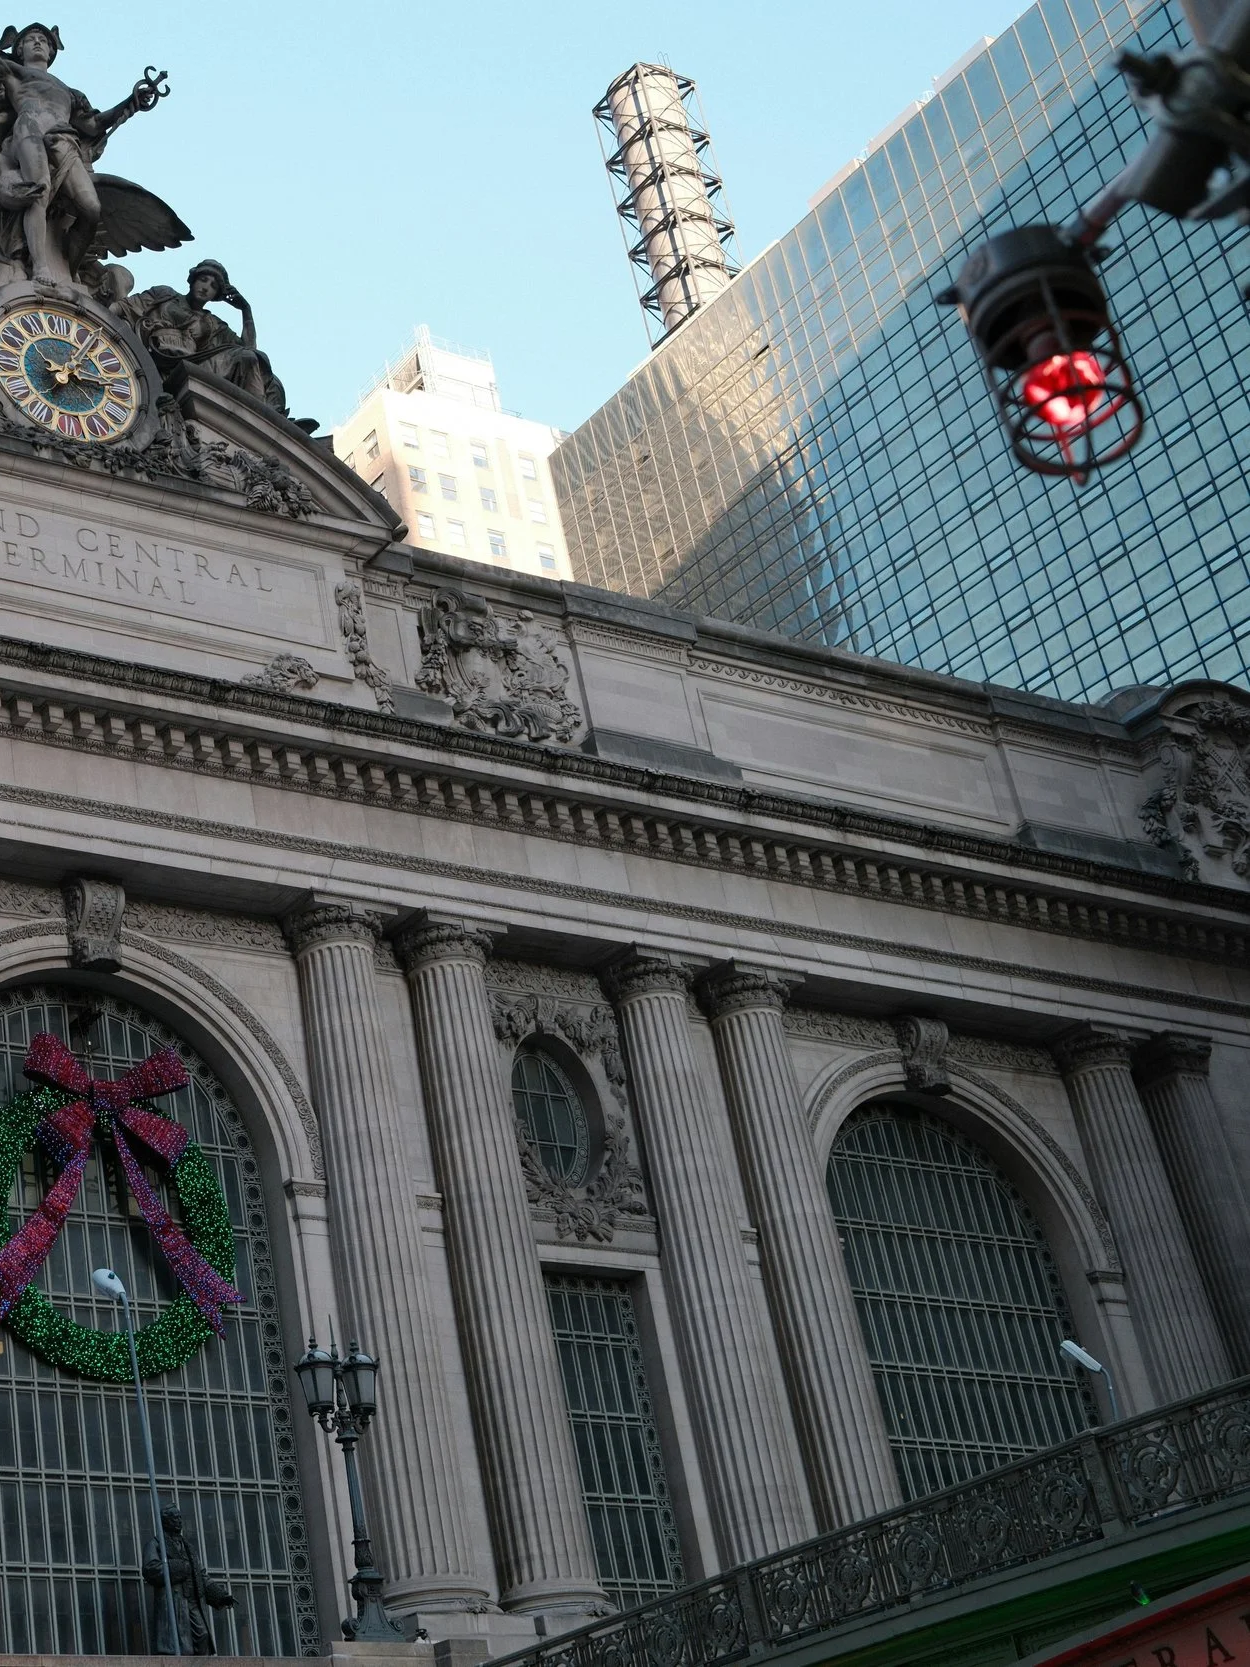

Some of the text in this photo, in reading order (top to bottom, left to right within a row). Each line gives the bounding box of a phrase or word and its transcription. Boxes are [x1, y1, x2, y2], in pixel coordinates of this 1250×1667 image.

[24, 315, 41, 335] XI
[52, 315, 68, 336] XII
[3, 328, 25, 347] X
[64, 415, 77, 436] VI
[76, 527, 273, 592] CENTRAL
